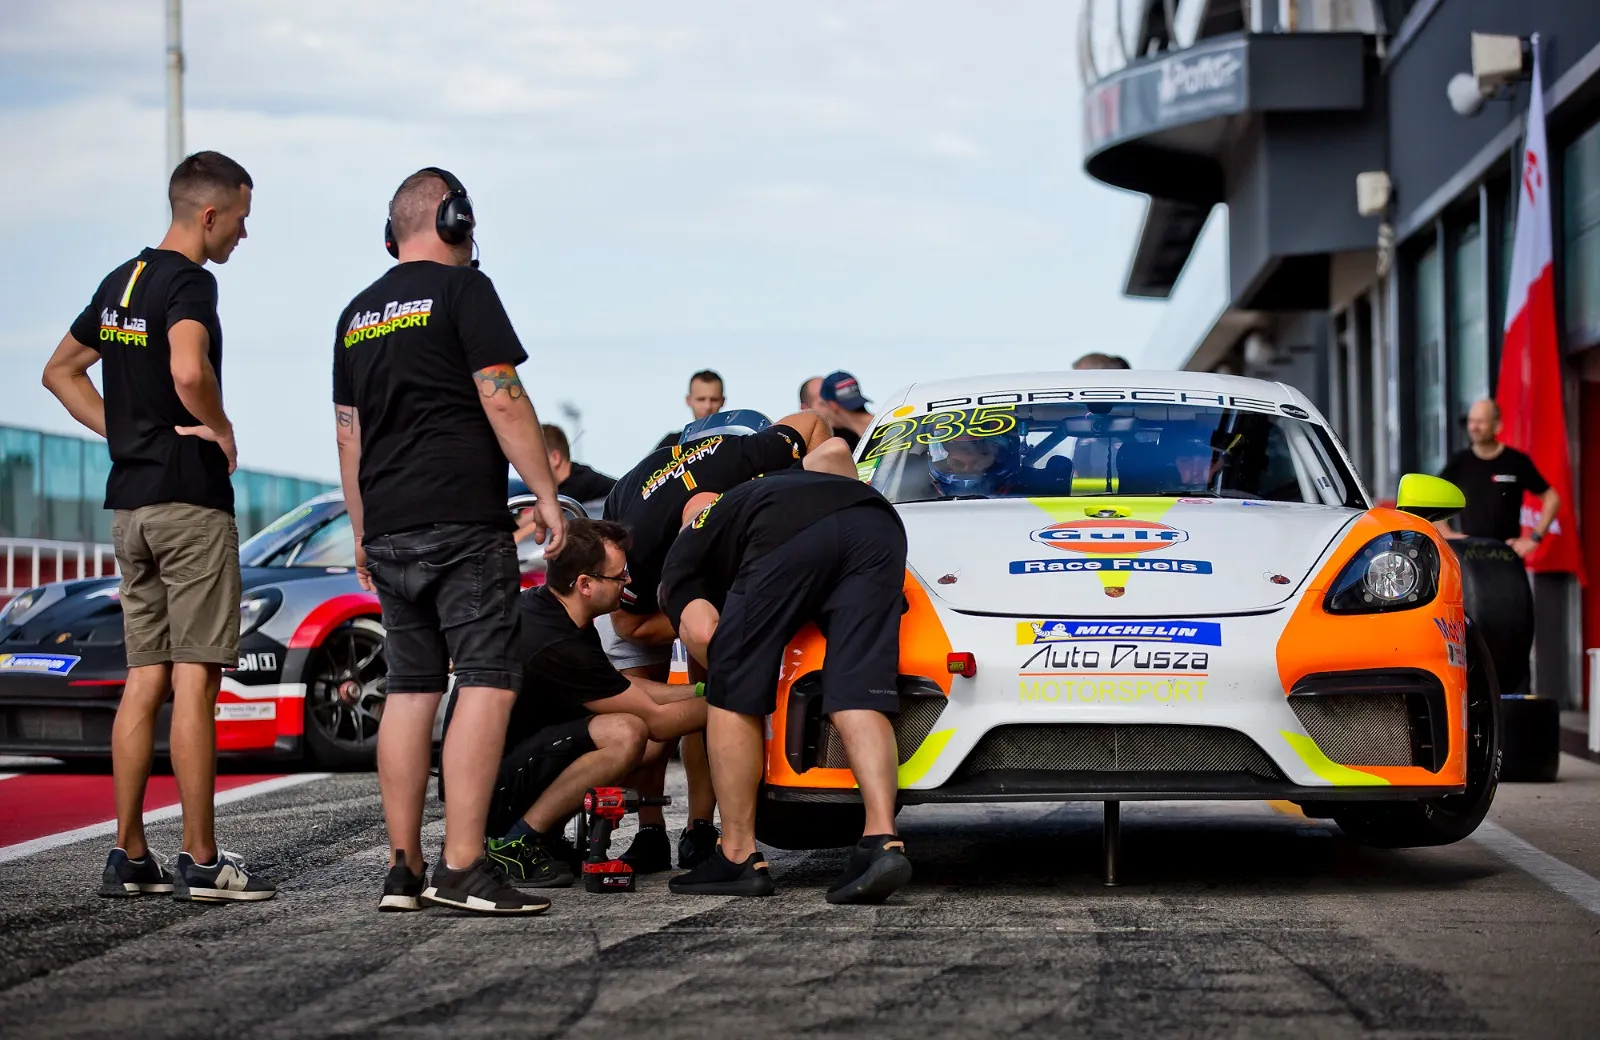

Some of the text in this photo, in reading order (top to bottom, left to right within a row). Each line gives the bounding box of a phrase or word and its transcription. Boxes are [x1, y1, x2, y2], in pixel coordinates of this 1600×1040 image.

[345, 299, 434, 334] Auto Dusza
[343, 312, 432, 349] MOTORSPORT
[926, 389, 1277, 414] PORSCHE
[865, 404, 1017, 461] 235
[642, 439, 723, 501] Auto Dusza
[1037, 529, 1180, 541] Gulf
[1024, 558, 1199, 573] Race Fuels
[1074, 624, 1199, 637] MICHELIN
[1019, 643, 1210, 671] Auto Dusza
[1018, 680, 1210, 703] MOTORSPORT
